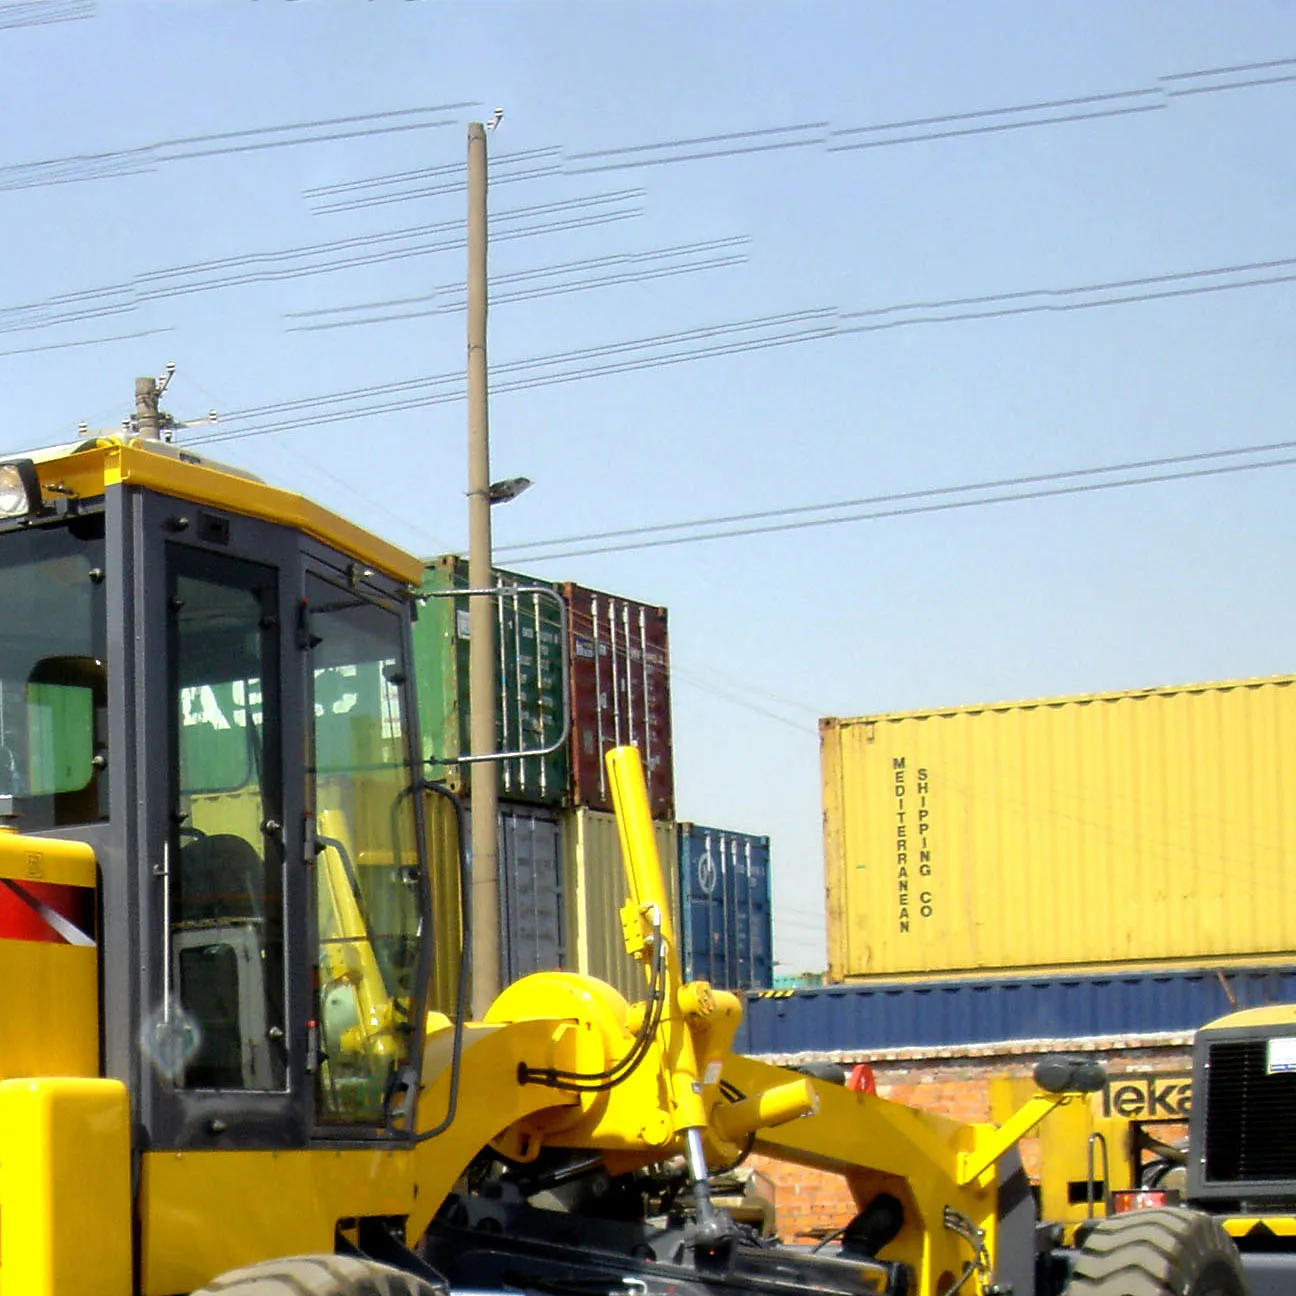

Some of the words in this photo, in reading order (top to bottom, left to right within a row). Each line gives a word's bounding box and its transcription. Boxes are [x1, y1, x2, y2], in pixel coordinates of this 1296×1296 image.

[892, 757, 910, 933] MEDITERRANEAN
[917, 768, 931, 877] SHIPPING
[919, 891, 933, 918] CO
